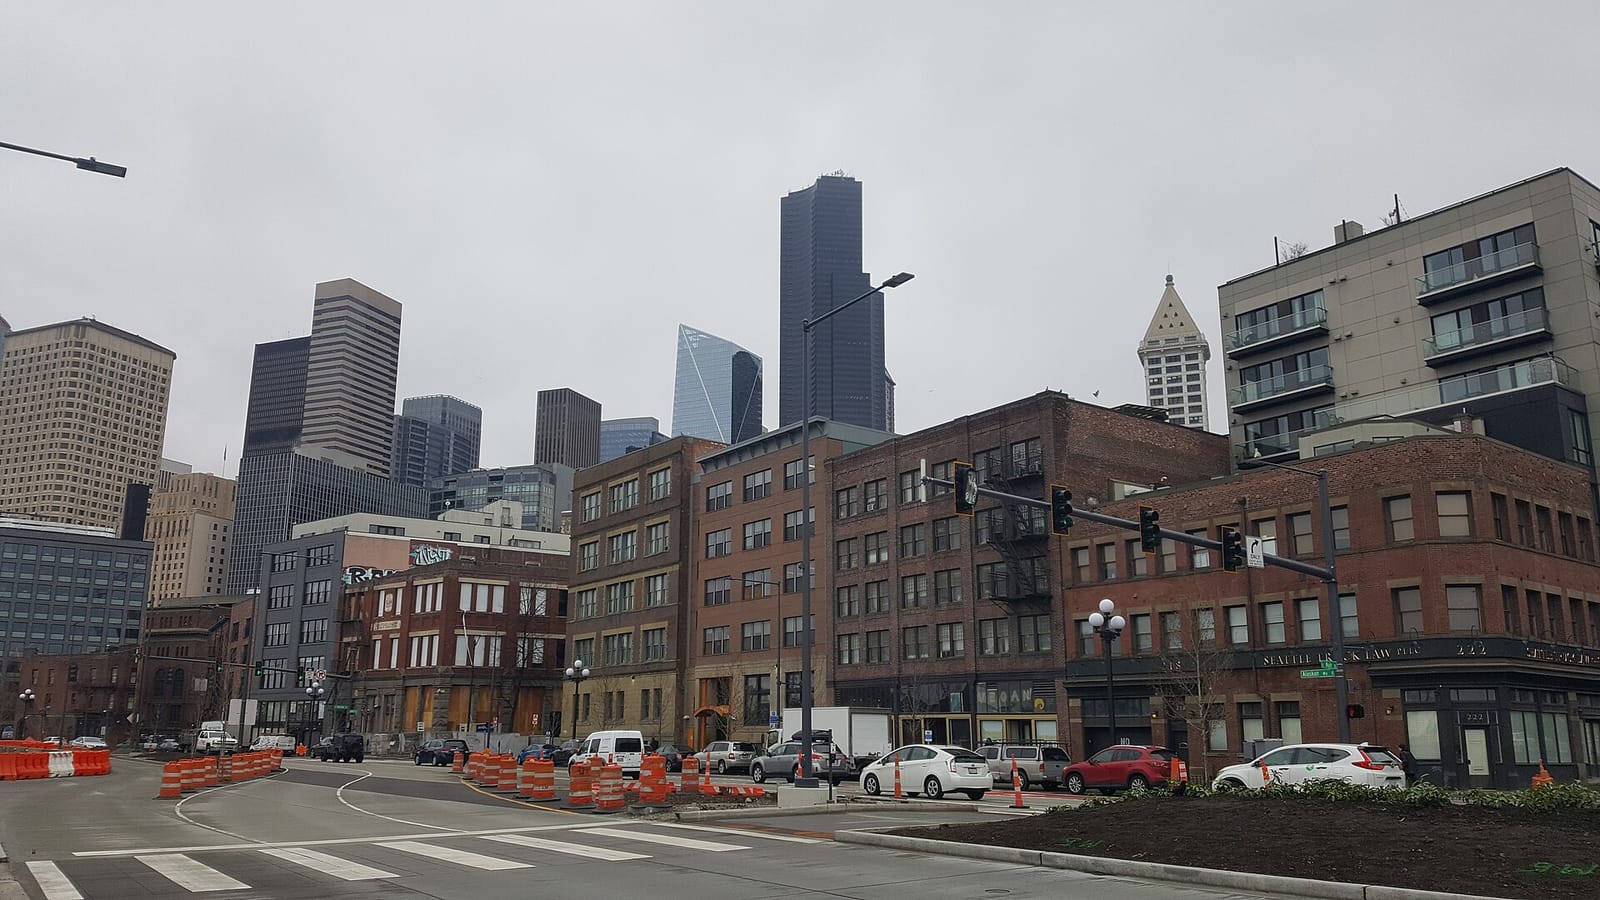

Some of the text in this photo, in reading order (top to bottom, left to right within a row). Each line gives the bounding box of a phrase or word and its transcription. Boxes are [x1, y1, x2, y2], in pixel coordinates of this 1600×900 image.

[1263, 654, 1312, 666] SEATTLE
[1318, 650, 1361, 663] TRCK
[1365, 648, 1392, 660] LAW
[1456, 644, 1487, 656] 222
[977, 688, 1032, 704] VEGAN
[1466, 713, 1484, 721] 222
